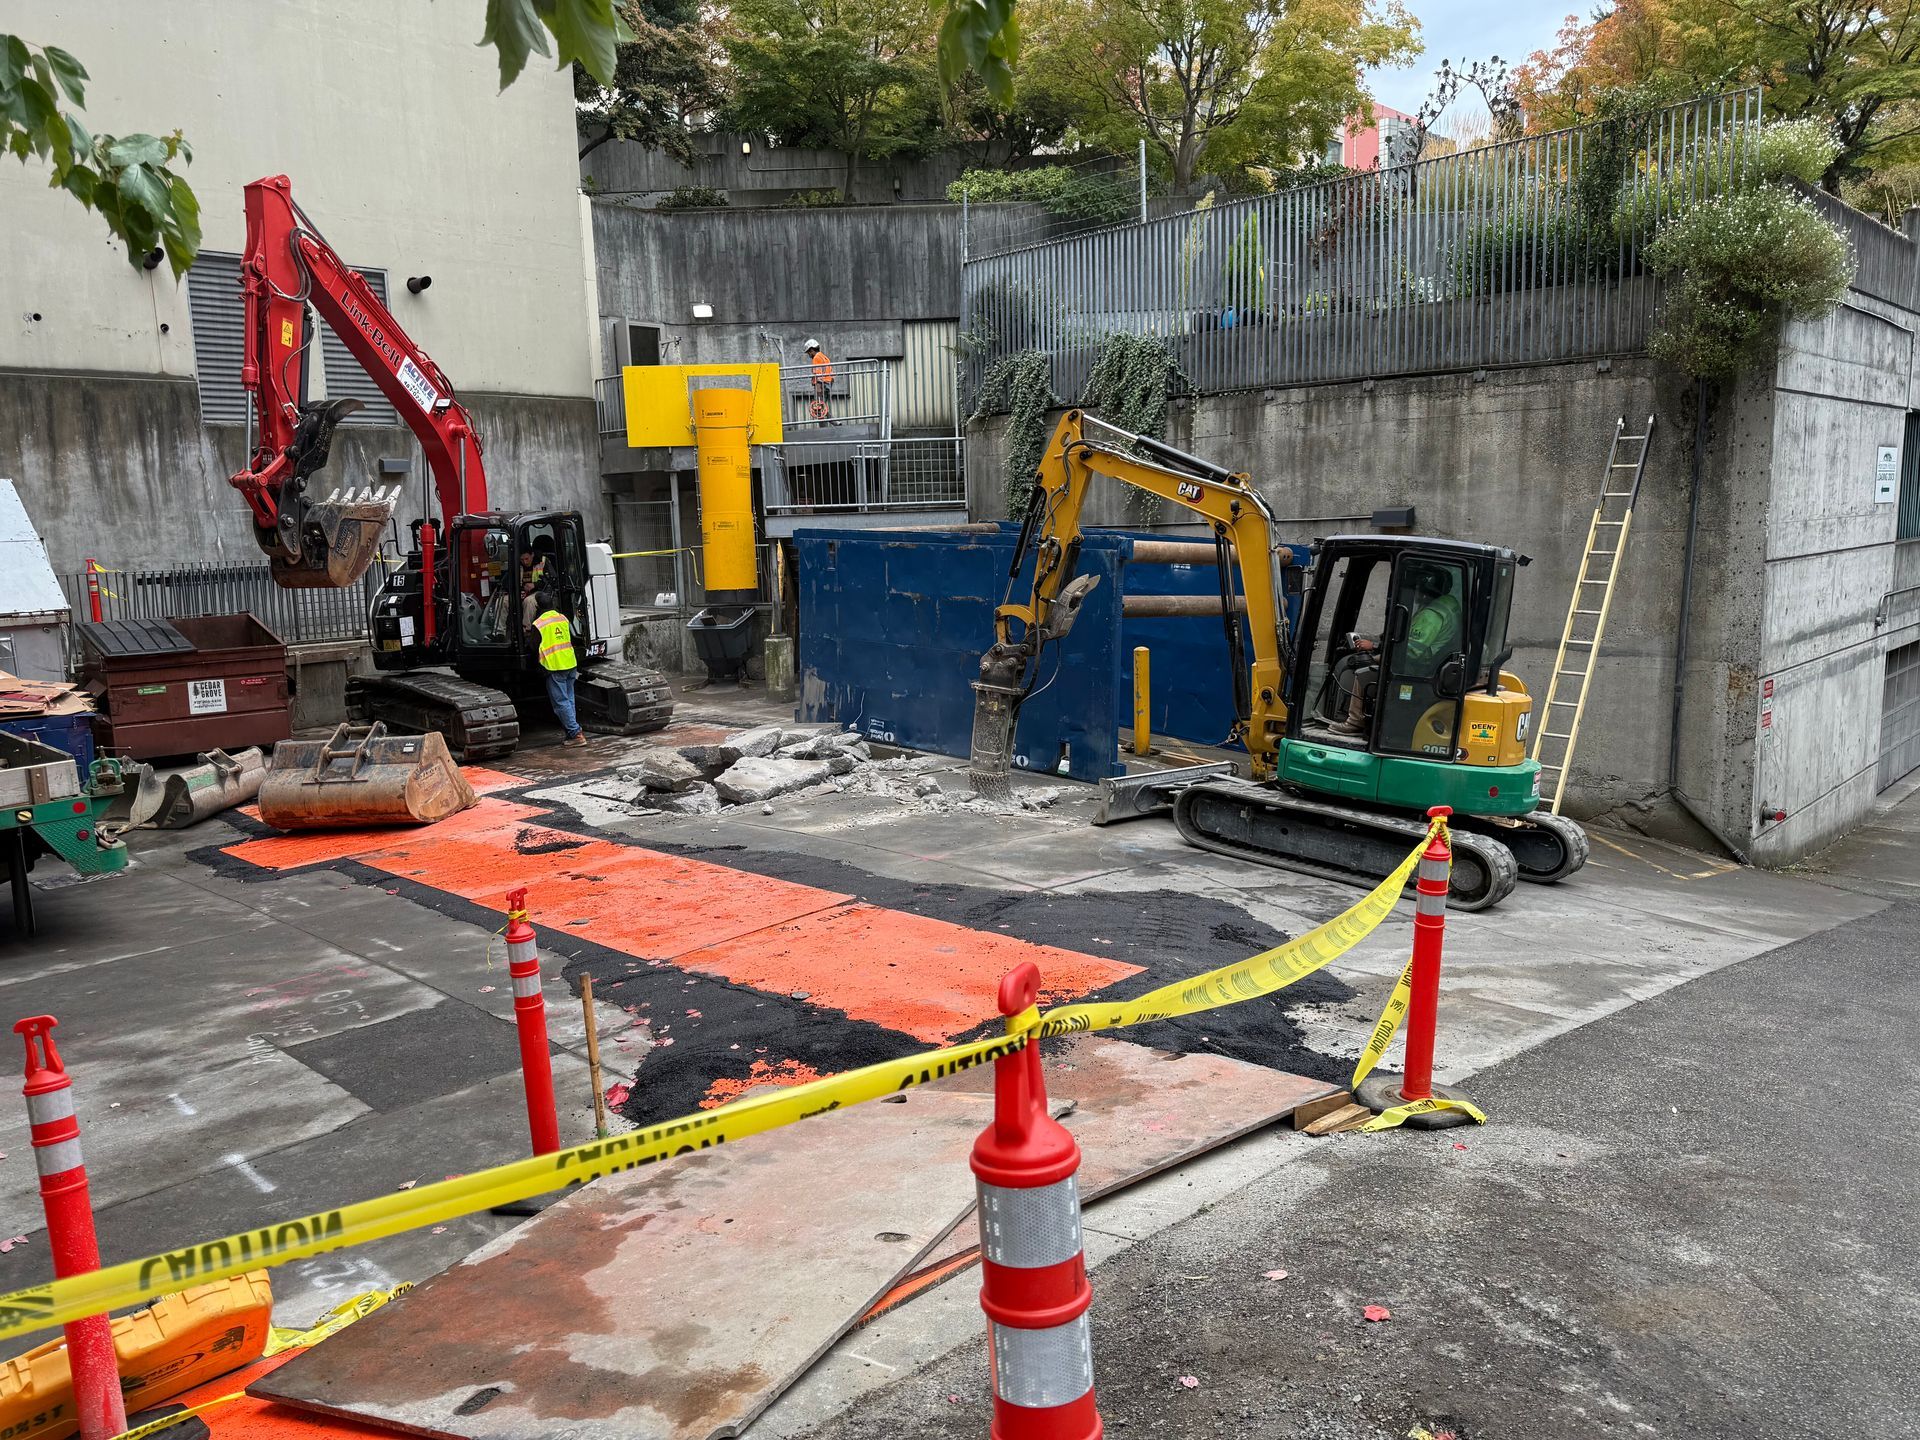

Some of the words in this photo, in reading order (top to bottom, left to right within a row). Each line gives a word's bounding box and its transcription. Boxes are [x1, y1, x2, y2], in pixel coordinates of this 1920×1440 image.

[340, 290, 402, 368] Link-Belt
[403, 361, 437, 399] ACTIVE
[1177, 481, 1201, 499] CAT
[394, 576, 404, 586] 15
[200, 681, 221, 690] CEDAR
[201, 689, 222, 699] GROVE
[1471, 723, 1497, 732] DEENY
